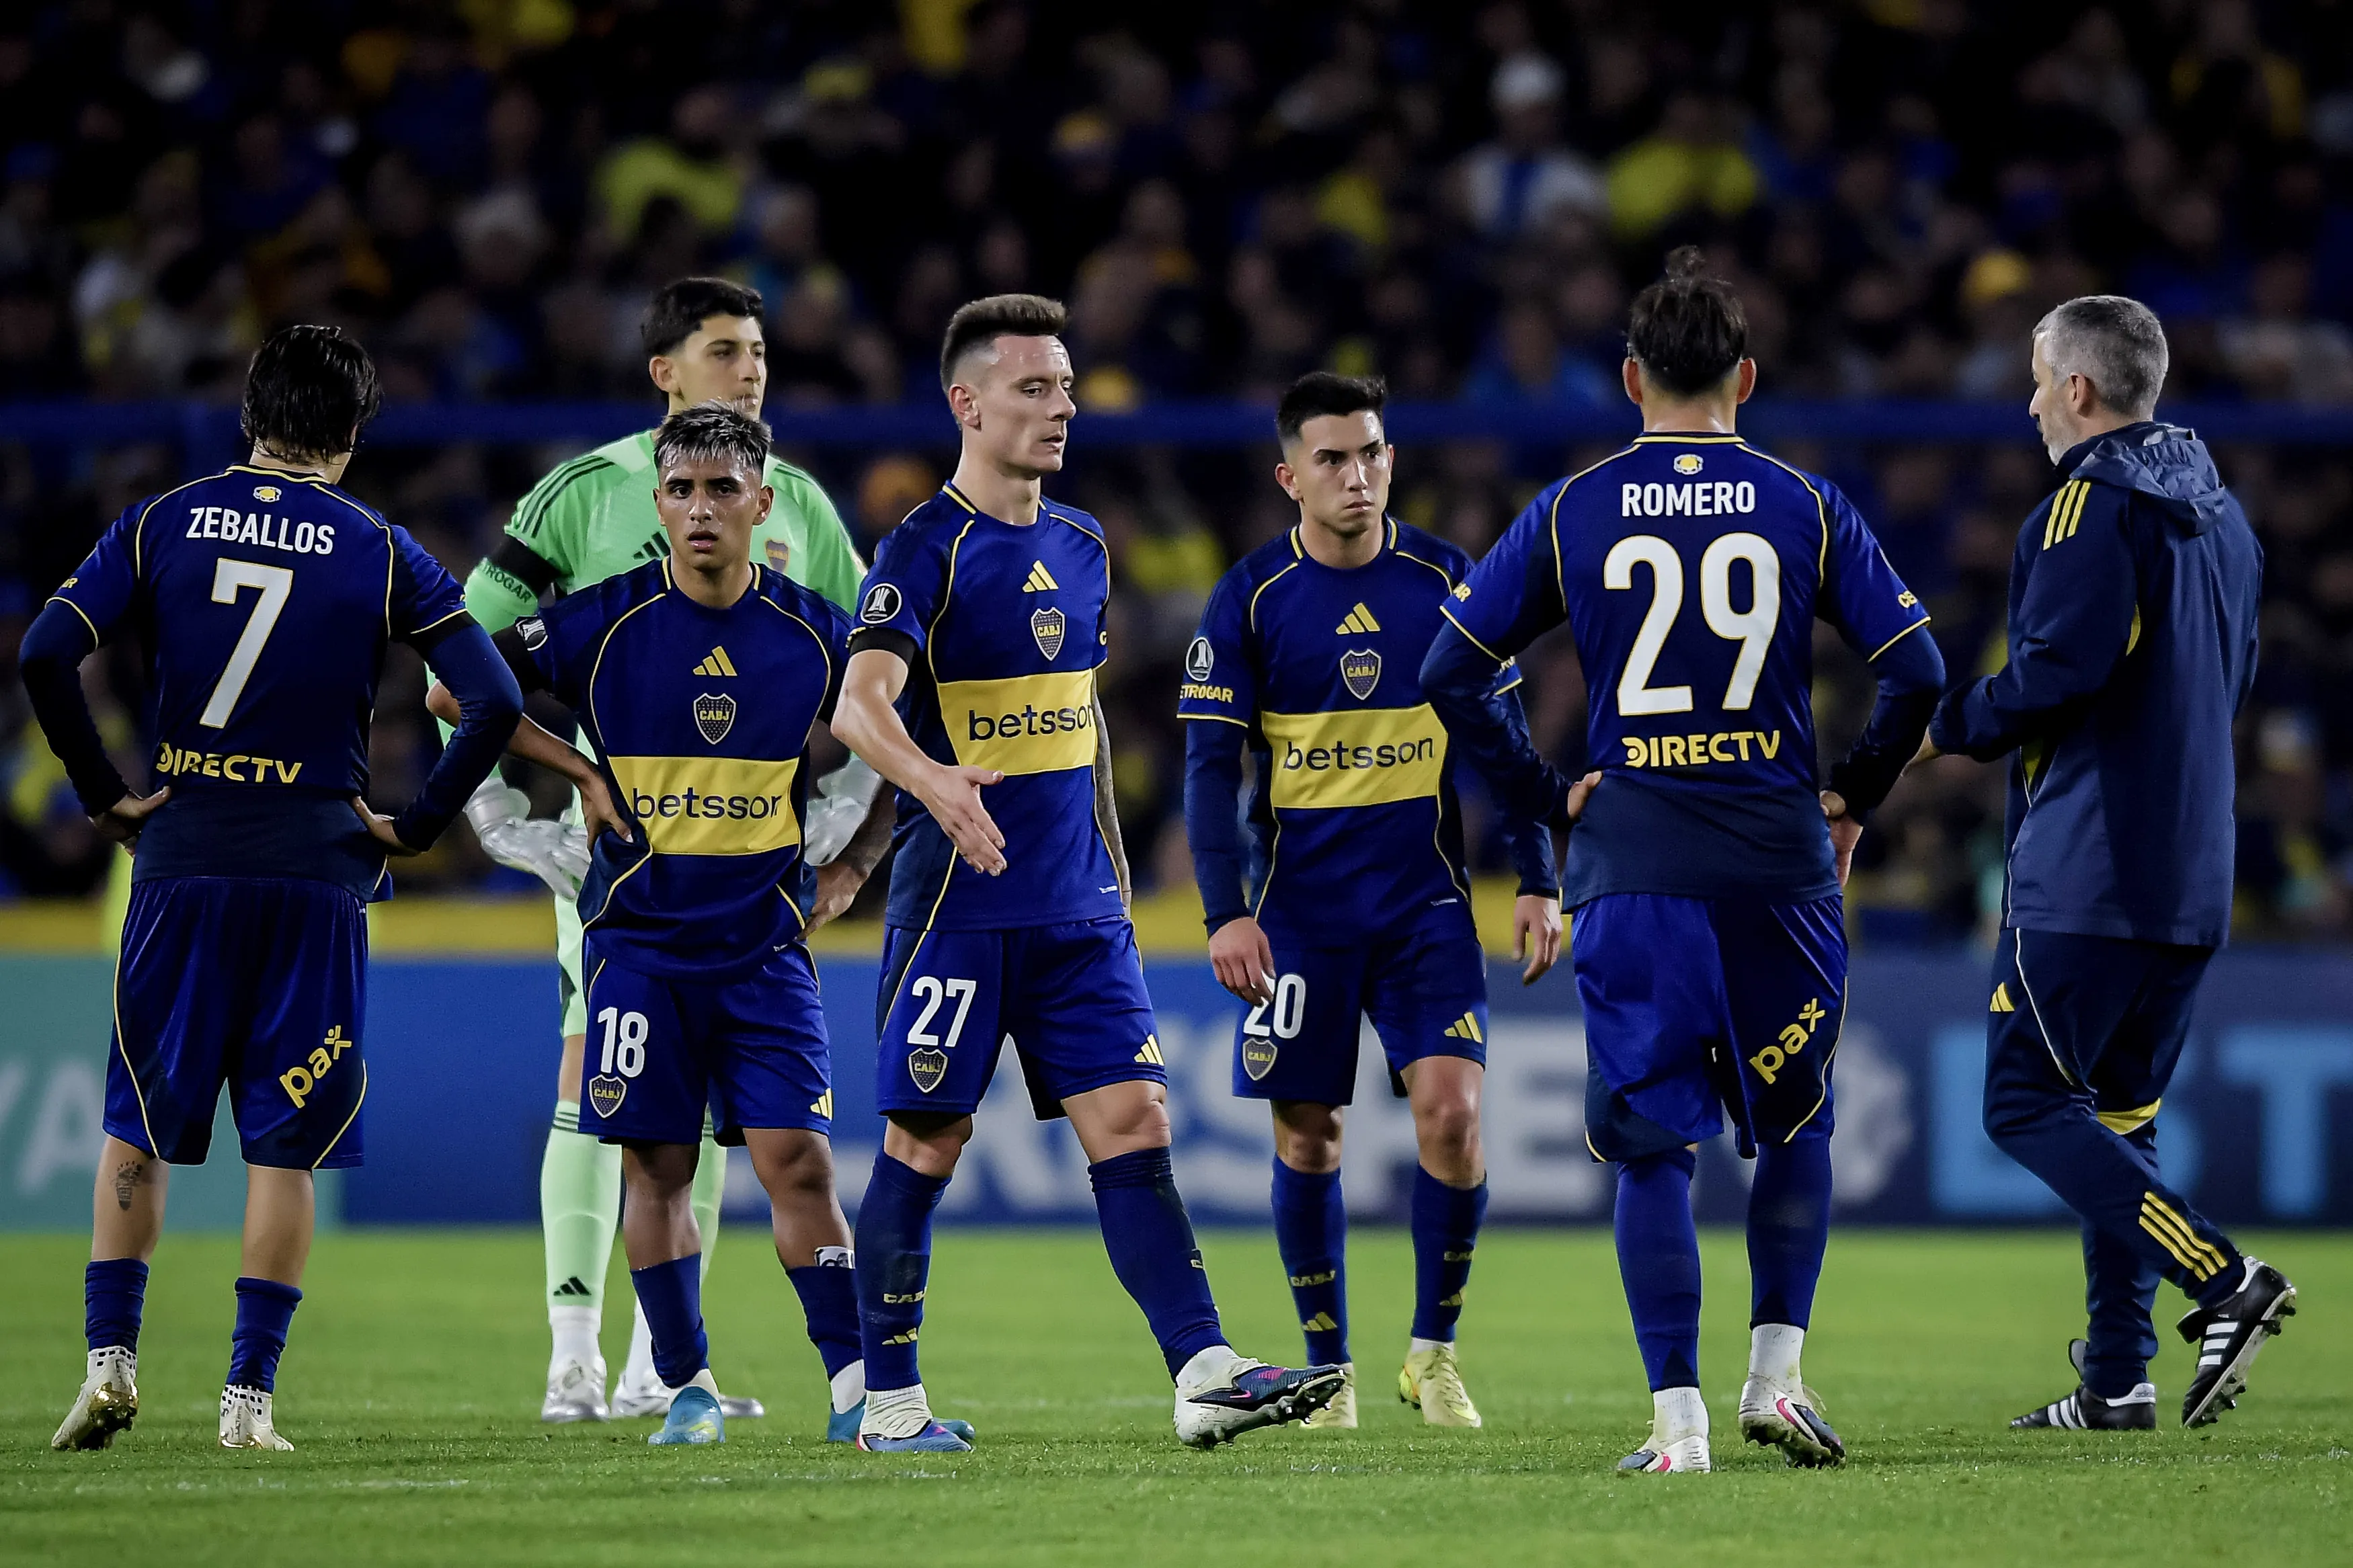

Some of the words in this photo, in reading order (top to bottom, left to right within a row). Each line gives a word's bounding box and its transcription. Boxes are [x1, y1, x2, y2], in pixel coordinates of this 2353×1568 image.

[1622, 481, 1756, 517] ROMERO
[186, 507, 335, 554] ZEBALLOS
[200, 557, 293, 729] 7
[1037, 624, 1060, 637] CABJ
[1604, 532, 1781, 716] 29
[1347, 665, 1375, 677] CABJ
[699, 710, 730, 720] CABJ
[156, 742, 302, 784] DIRECTV
[1283, 737, 1433, 771] betsson
[1622, 730, 1780, 768] DIRECTV
[907, 976, 977, 1047] 27
[1243, 970, 1306, 1039] 20
[598, 1006, 649, 1078] 18
[1749, 997, 1826, 1085] pax
[279, 1025, 352, 1108] pax
[594, 1088, 621, 1100] CABJ
